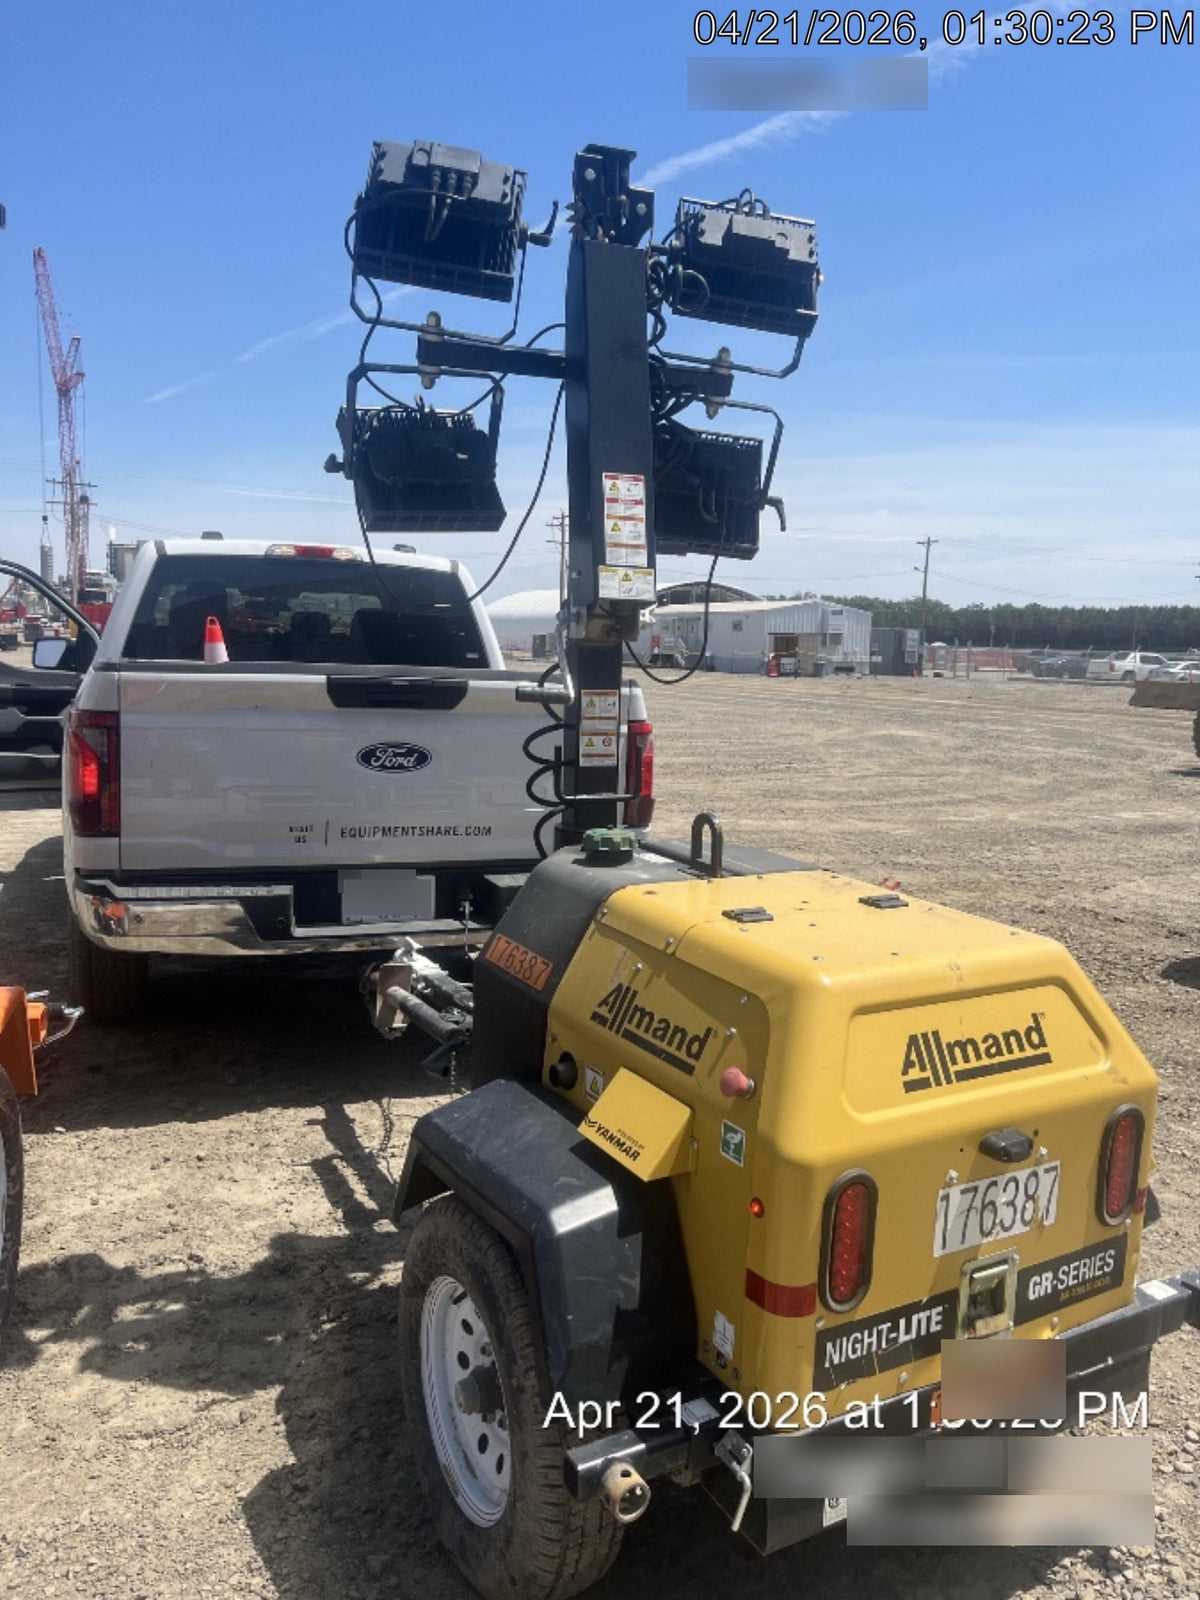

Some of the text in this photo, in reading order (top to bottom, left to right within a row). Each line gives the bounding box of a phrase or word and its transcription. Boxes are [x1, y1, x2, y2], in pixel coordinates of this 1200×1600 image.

[370, 747, 418, 767] Ford
[340, 825, 492, 839] EQUIPMENTSHARE.COM
[488, 936, 550, 986] 176387
[597, 982, 713, 1062] Allmand
[901, 1012, 1048, 1086] Allmand
[595, 1123, 641, 1161] YANMAR
[940, 1165, 1059, 1250] 176387
[1028, 1249, 1116, 1301] GR-SERIES
[824, 1305, 944, 1368] NIGHT-LITE
